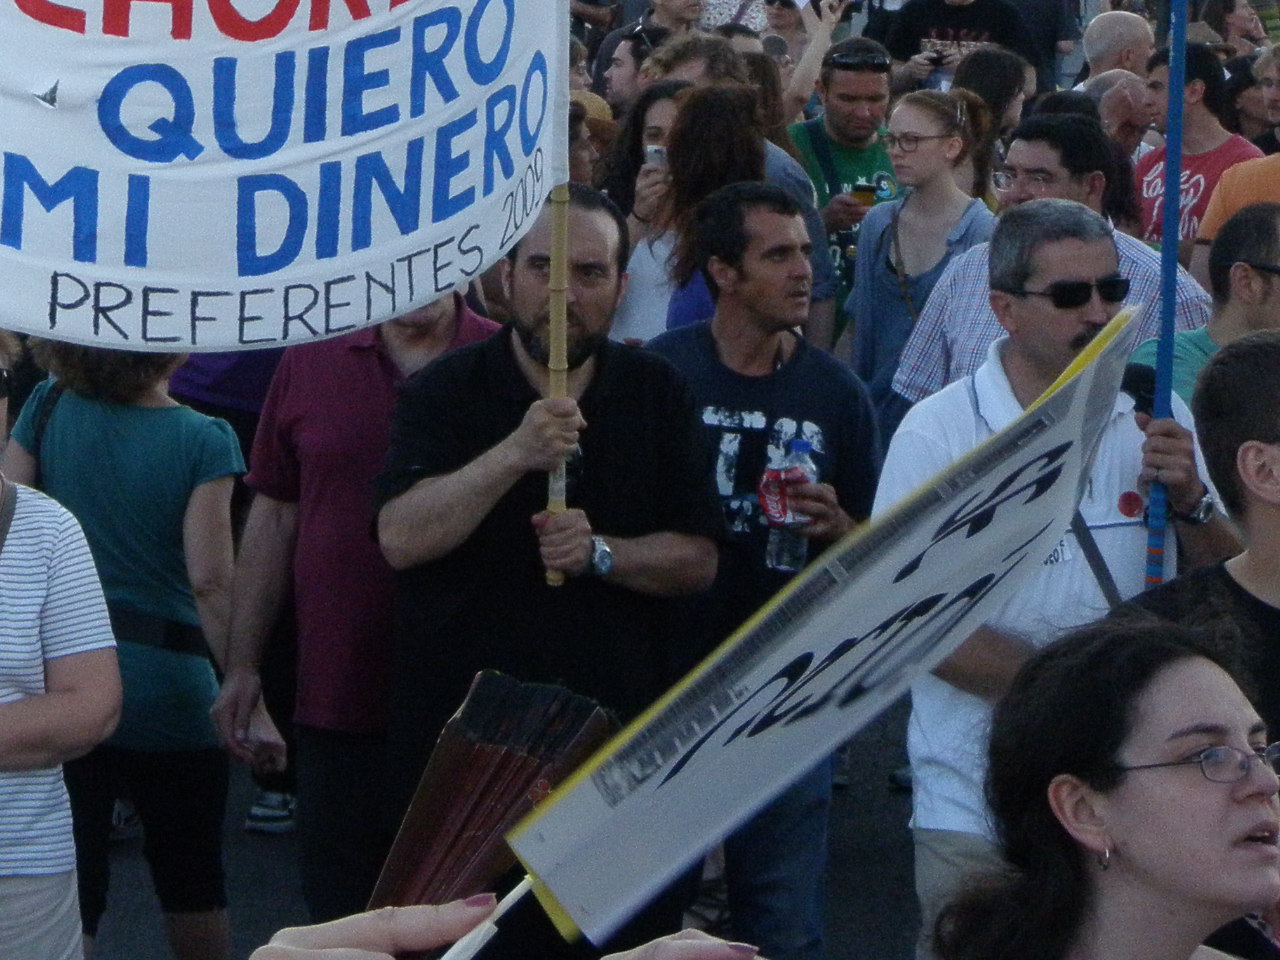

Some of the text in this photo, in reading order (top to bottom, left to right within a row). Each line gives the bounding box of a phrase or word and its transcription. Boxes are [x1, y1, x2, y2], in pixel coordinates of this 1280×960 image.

[48, 146, 544, 345] PREFERENTES 2009
[235, 49, 548, 277] DINERO
